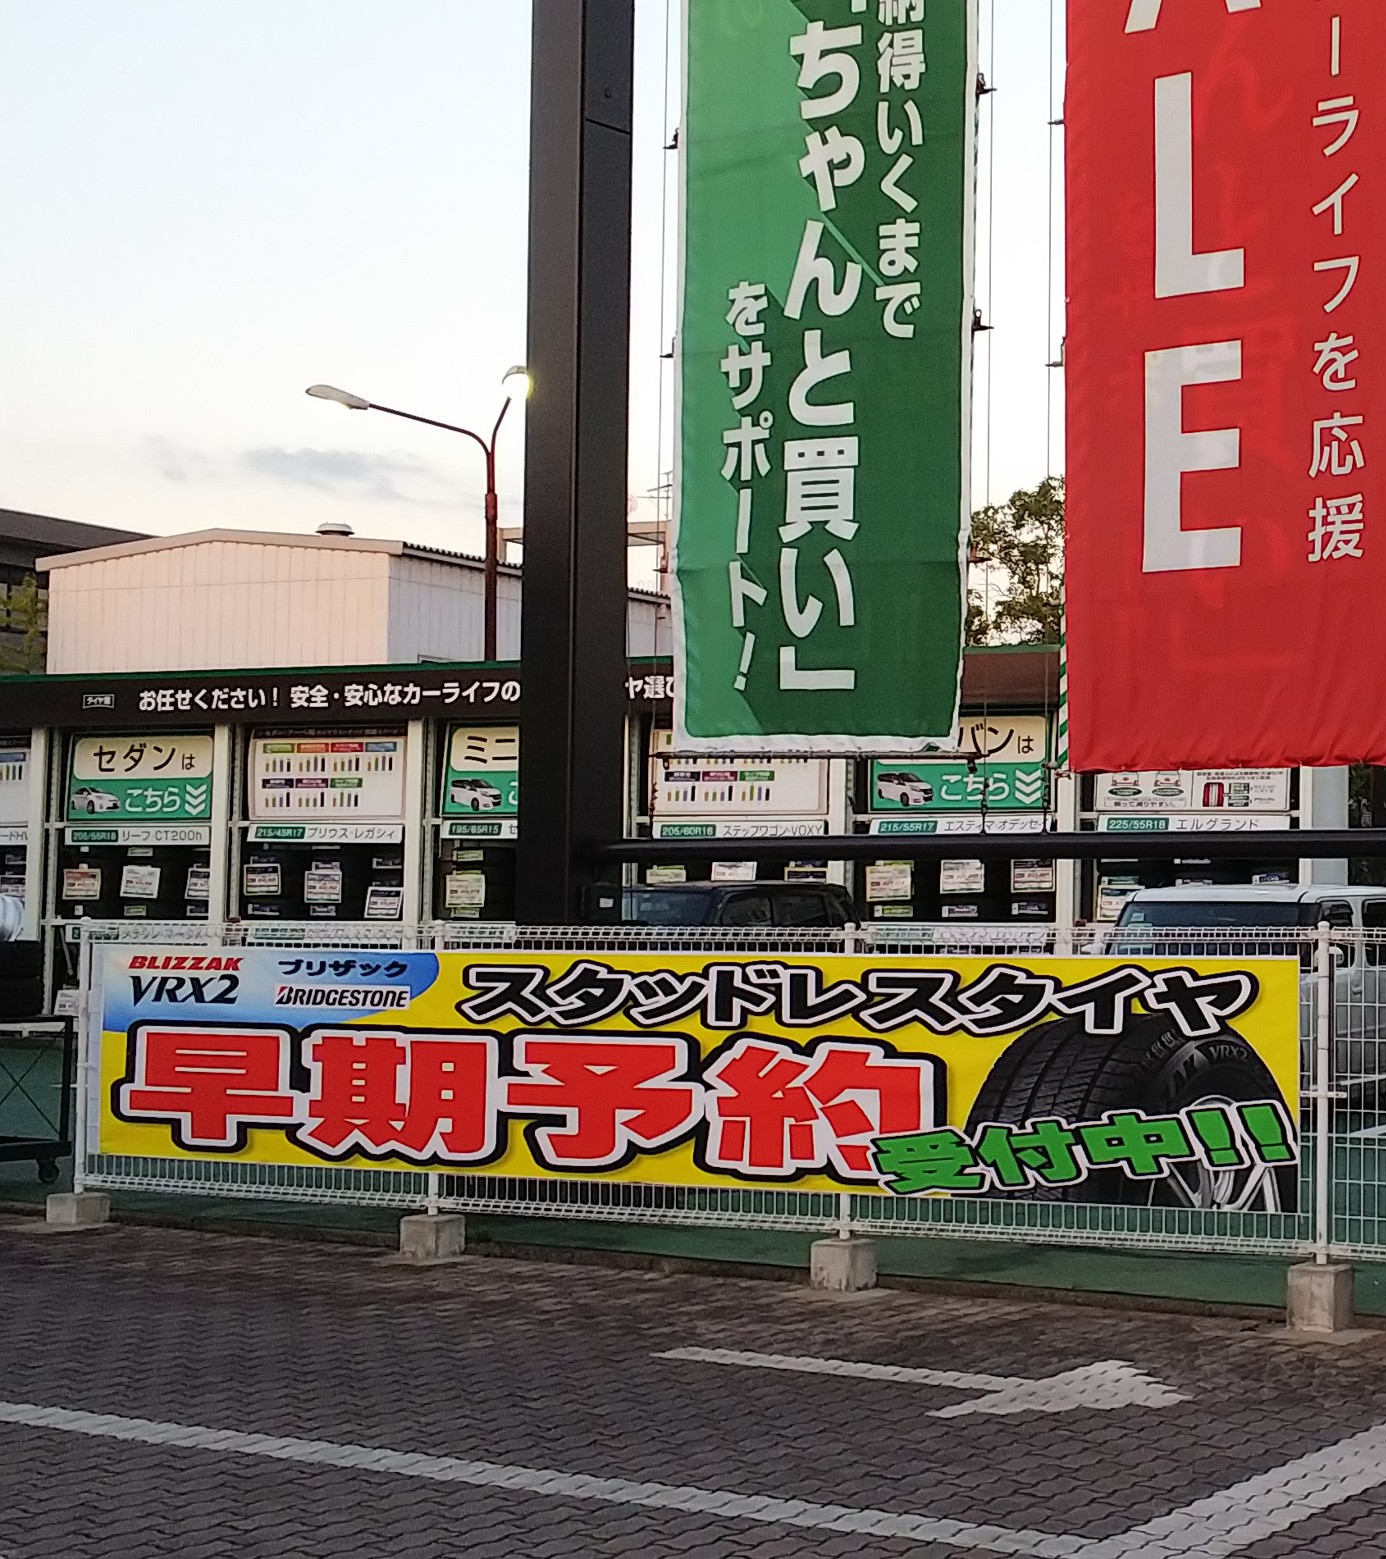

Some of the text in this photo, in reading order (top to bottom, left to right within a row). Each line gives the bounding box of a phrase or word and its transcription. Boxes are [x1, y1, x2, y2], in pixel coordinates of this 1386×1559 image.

[1122, 0, 1262, 574] LE
[778, 0, 867, 691] ちゃんと買い」
[93, 742, 196, 773] セダンは
[124, 786, 181, 813] こちら
[940, 773, 1011, 801] こちら
[122, 830, 152, 842] リーフ
[1176, 817, 1259, 831] エルグランド
[128, 954, 244, 972] BLIZZAK
[278, 957, 409, 979] ブリザック
[131, 974, 240, 1007] VRX2
[274, 983, 409, 1010] BRIDGESTONE
[457, 960, 1258, 1036] スタッドレスタイヤ
[118, 1024, 945, 1178] 早期予約
